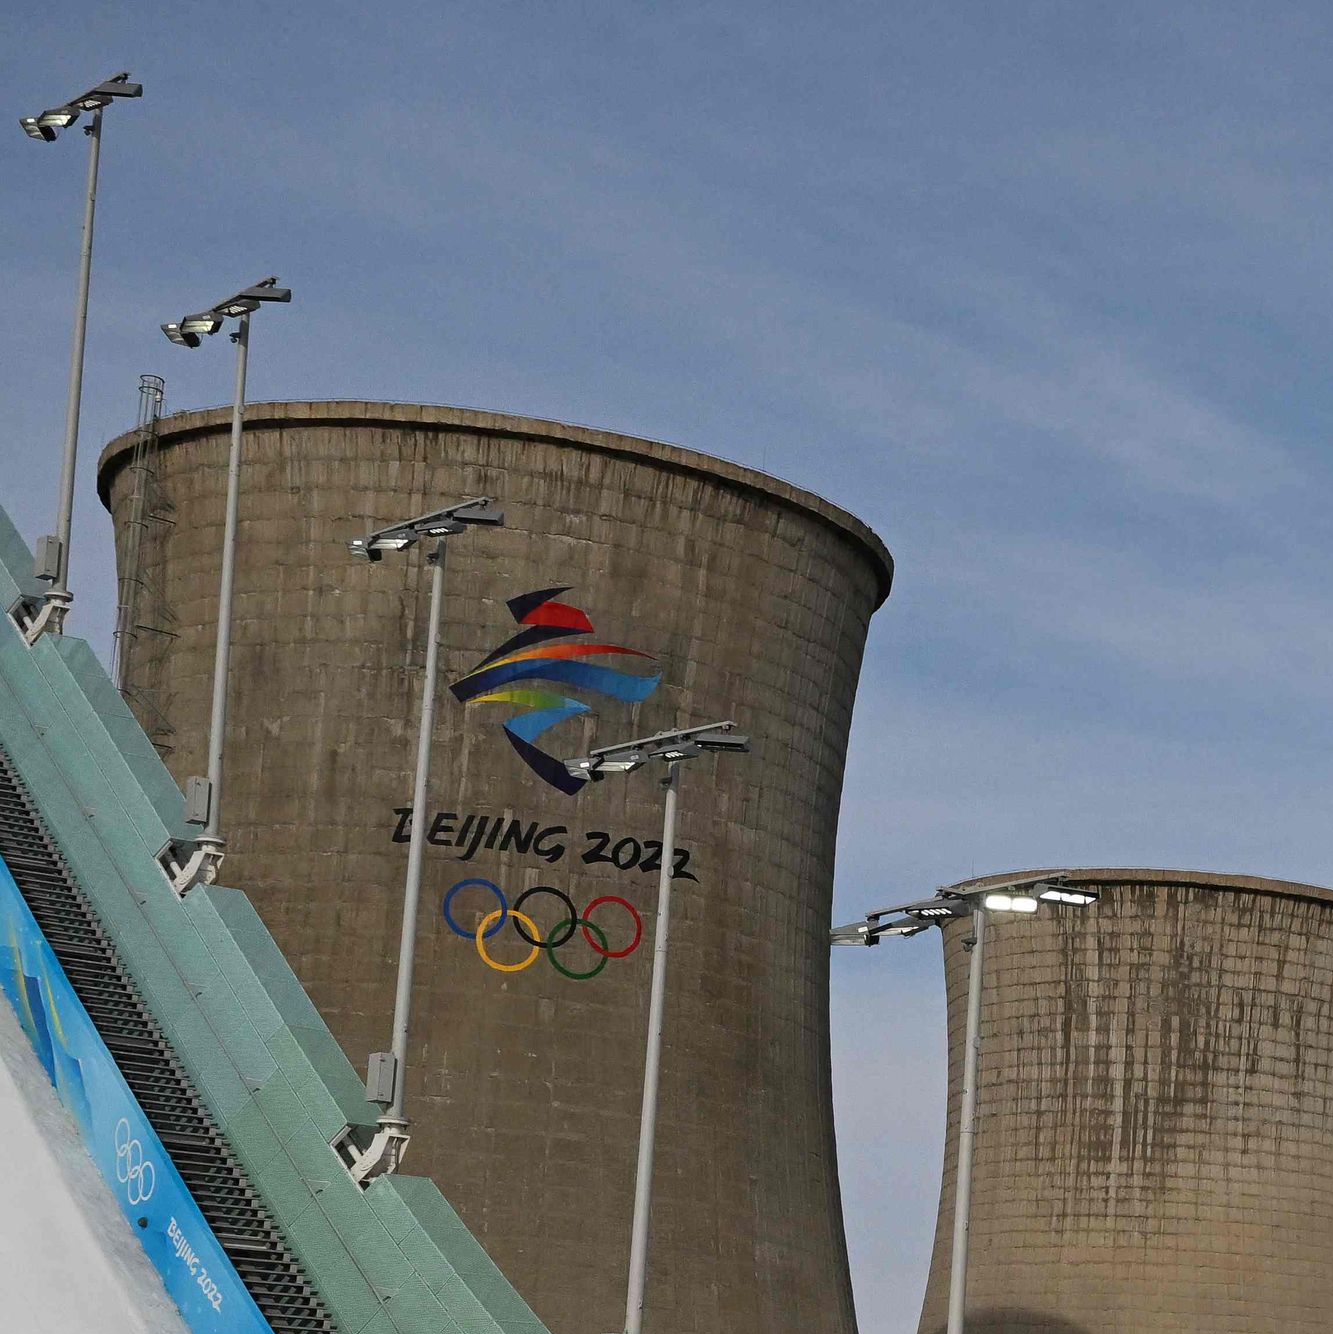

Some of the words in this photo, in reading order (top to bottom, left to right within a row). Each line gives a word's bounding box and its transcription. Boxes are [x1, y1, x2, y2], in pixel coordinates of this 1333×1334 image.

[582, 830, 700, 883] 2022
[167, 1216, 200, 1276] BEIJING
[197, 1268, 222, 1313] 2022
